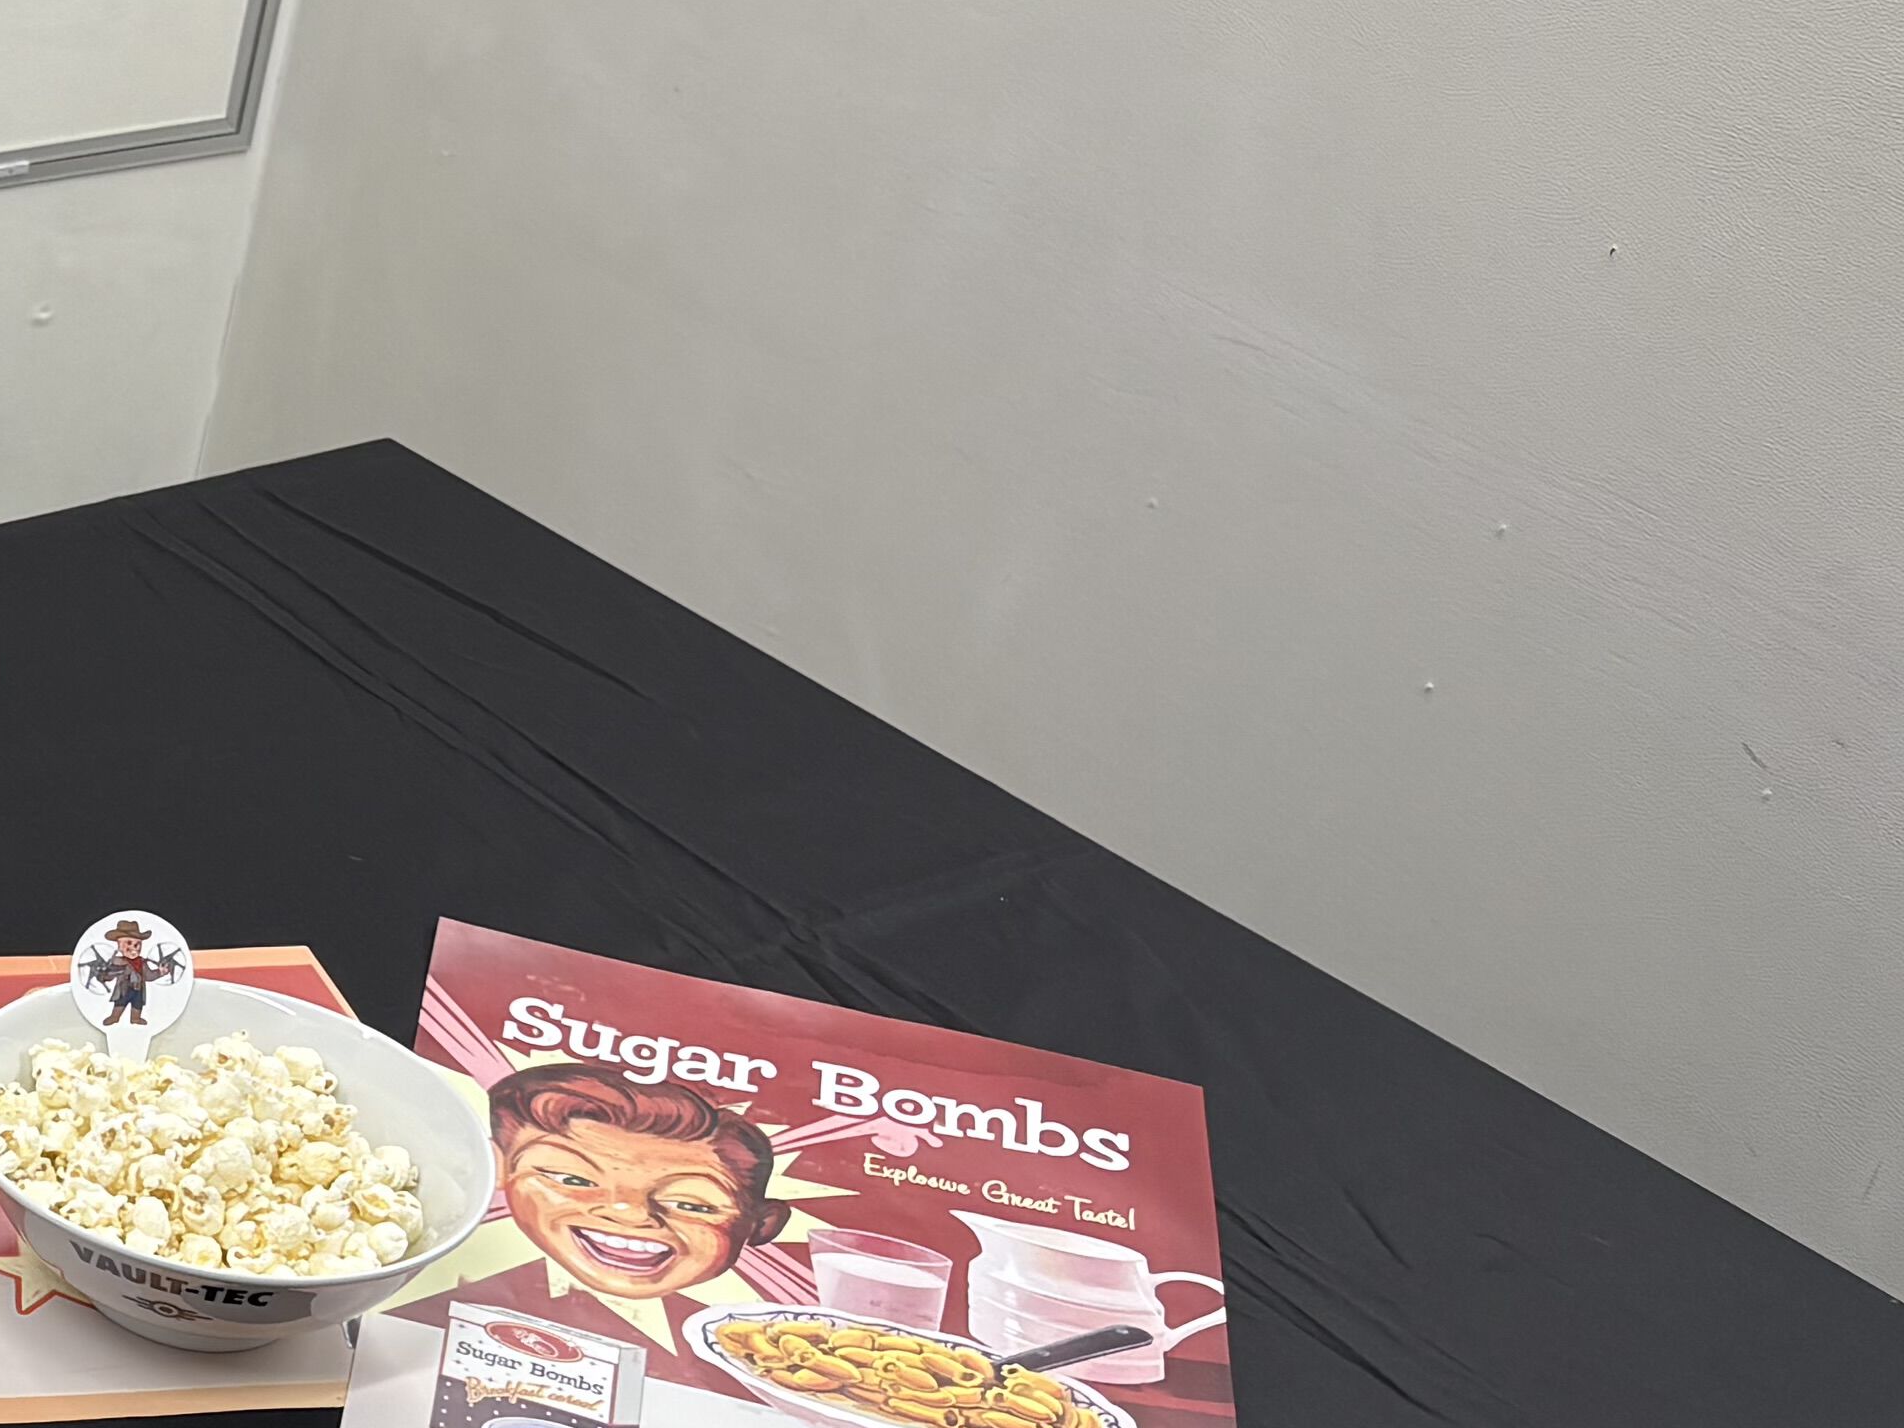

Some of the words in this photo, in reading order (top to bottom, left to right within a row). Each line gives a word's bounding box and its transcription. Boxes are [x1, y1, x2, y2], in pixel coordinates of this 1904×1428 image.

[499, 994, 778, 1095] Sugar
[810, 1058, 1134, 1174] Bombs
[863, 1152, 972, 1198] Explosive
[982, 1179, 1061, 1217] Great
[1065, 1193, 1137, 1232] Taste!
[68, 1238, 274, 1308] VAULT-TEC
[455, 1340, 524, 1376] Sugar
[529, 1361, 605, 1396] Bombs
